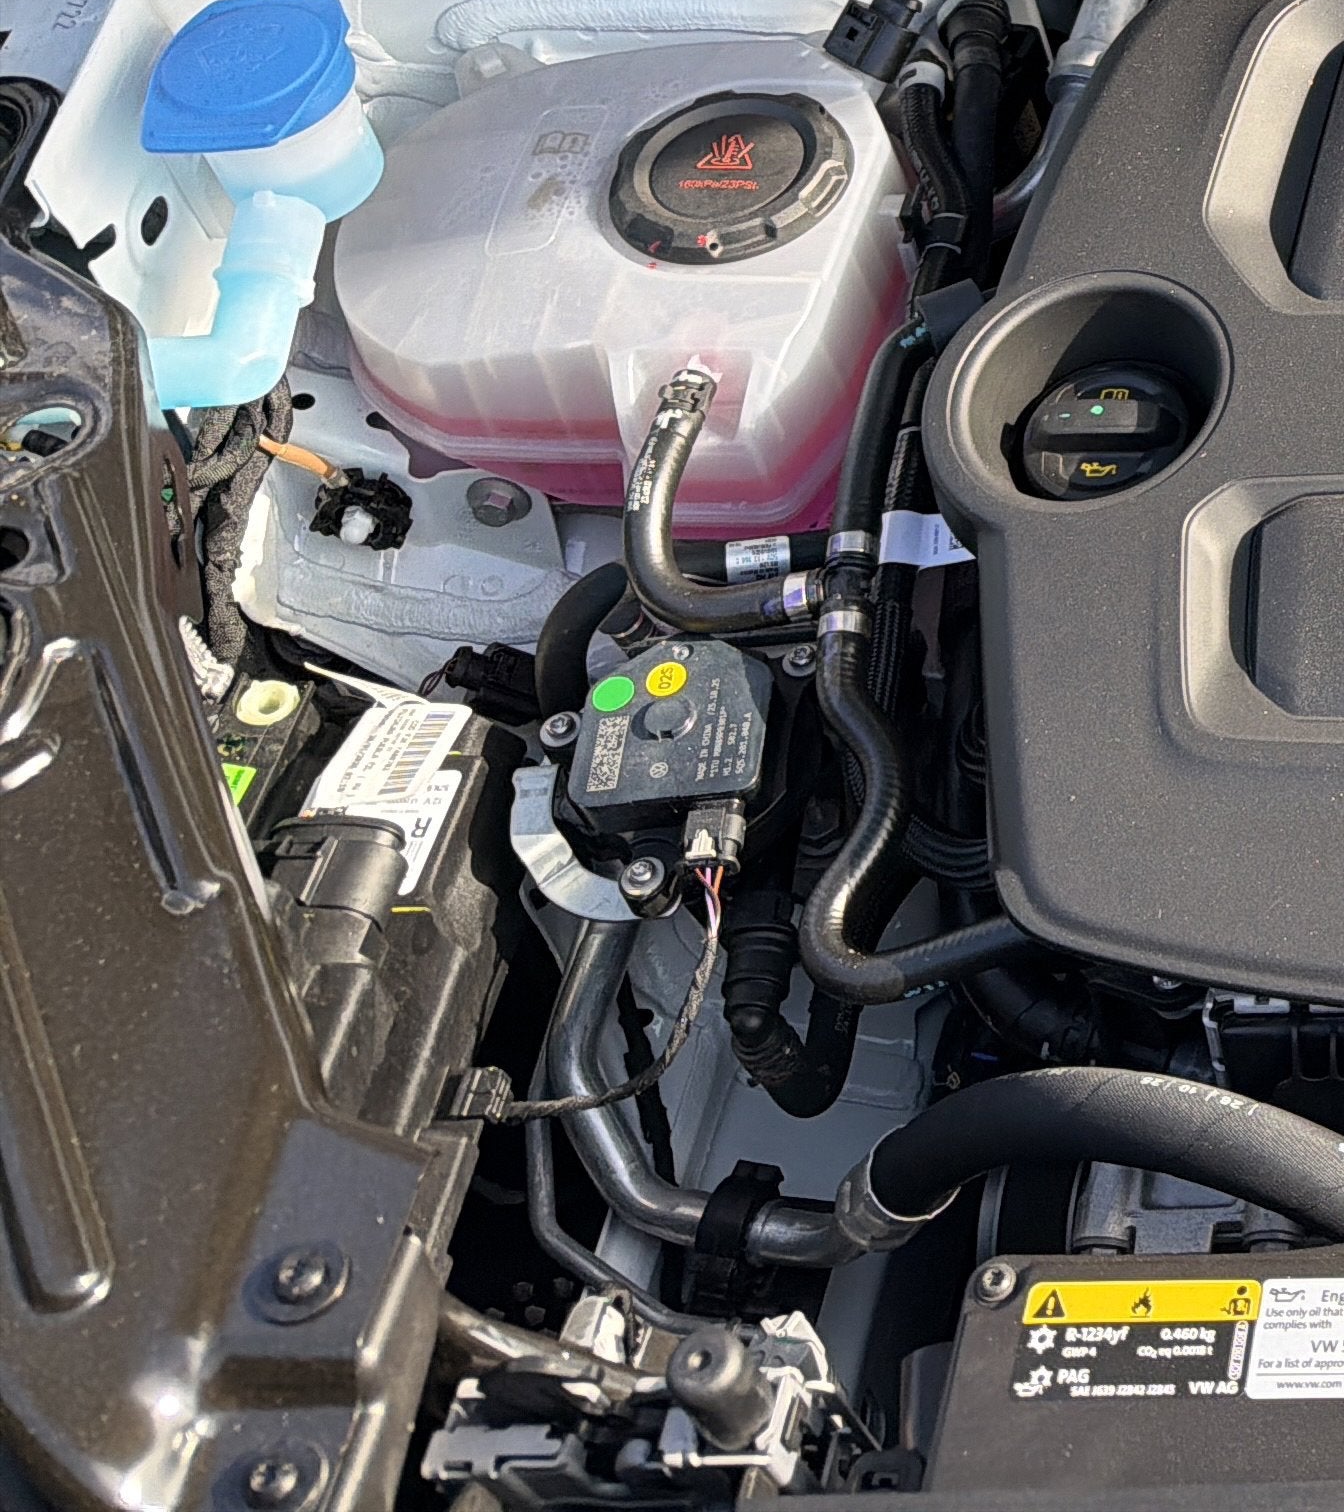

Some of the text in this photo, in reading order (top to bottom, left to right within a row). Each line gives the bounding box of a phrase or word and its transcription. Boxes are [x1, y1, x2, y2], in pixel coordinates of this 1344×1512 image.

[1266, 1307, 1285, 1317] Use
[1286, 1307, 1307, 1319] only
[1309, 1307, 1320, 1317] oil
[1323, 1307, 1343, 1317] that
[1263, 1320, 1307, 1331] complies
[1309, 1319, 1332, 1329] with
[1064, 1326, 1130, 1345] R-1234yf
[1311, 1340, 1338, 1353] VW
[1258, 1359, 1273, 1368] For
[1275, 1360, 1282, 1368] a
[1284, 1358, 1299, 1368] list
[1302, 1358, 1313, 1368] of
[1056, 1369, 1239, 1395] PAG VW AG
